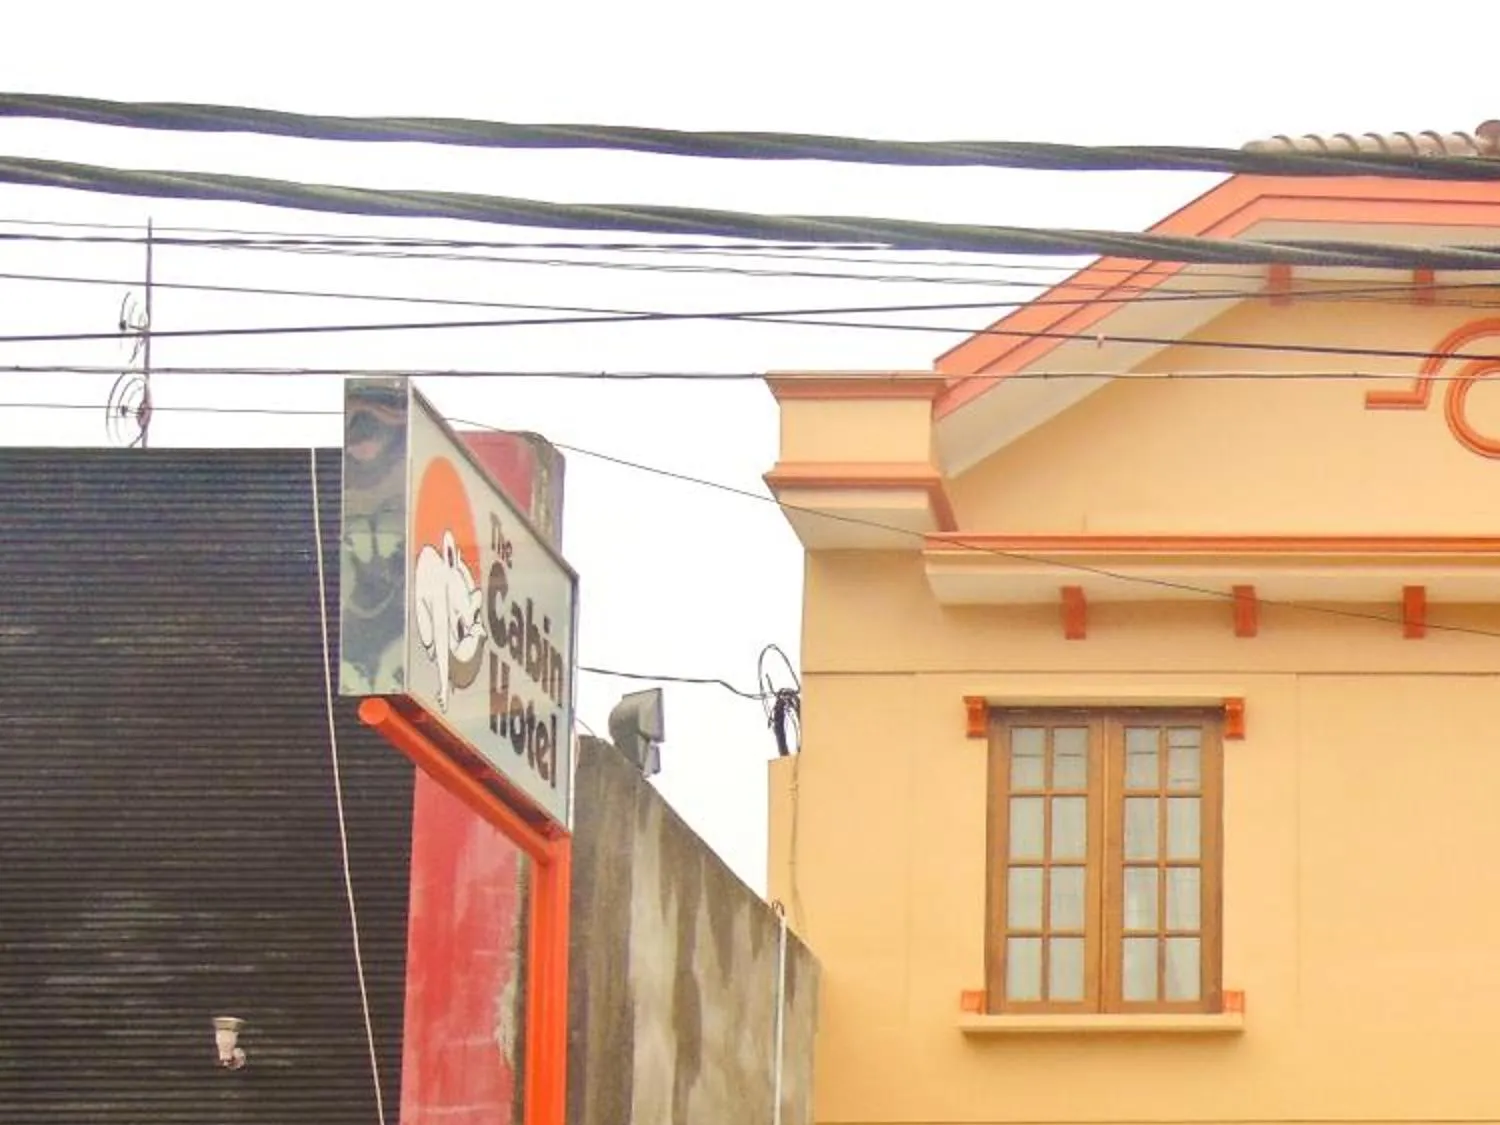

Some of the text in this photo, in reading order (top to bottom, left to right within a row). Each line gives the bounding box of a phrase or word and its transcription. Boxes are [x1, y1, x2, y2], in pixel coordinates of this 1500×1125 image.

[490, 511, 513, 569] The
[487, 560, 563, 708] Cabin
[488, 651, 557, 789] Hotel
